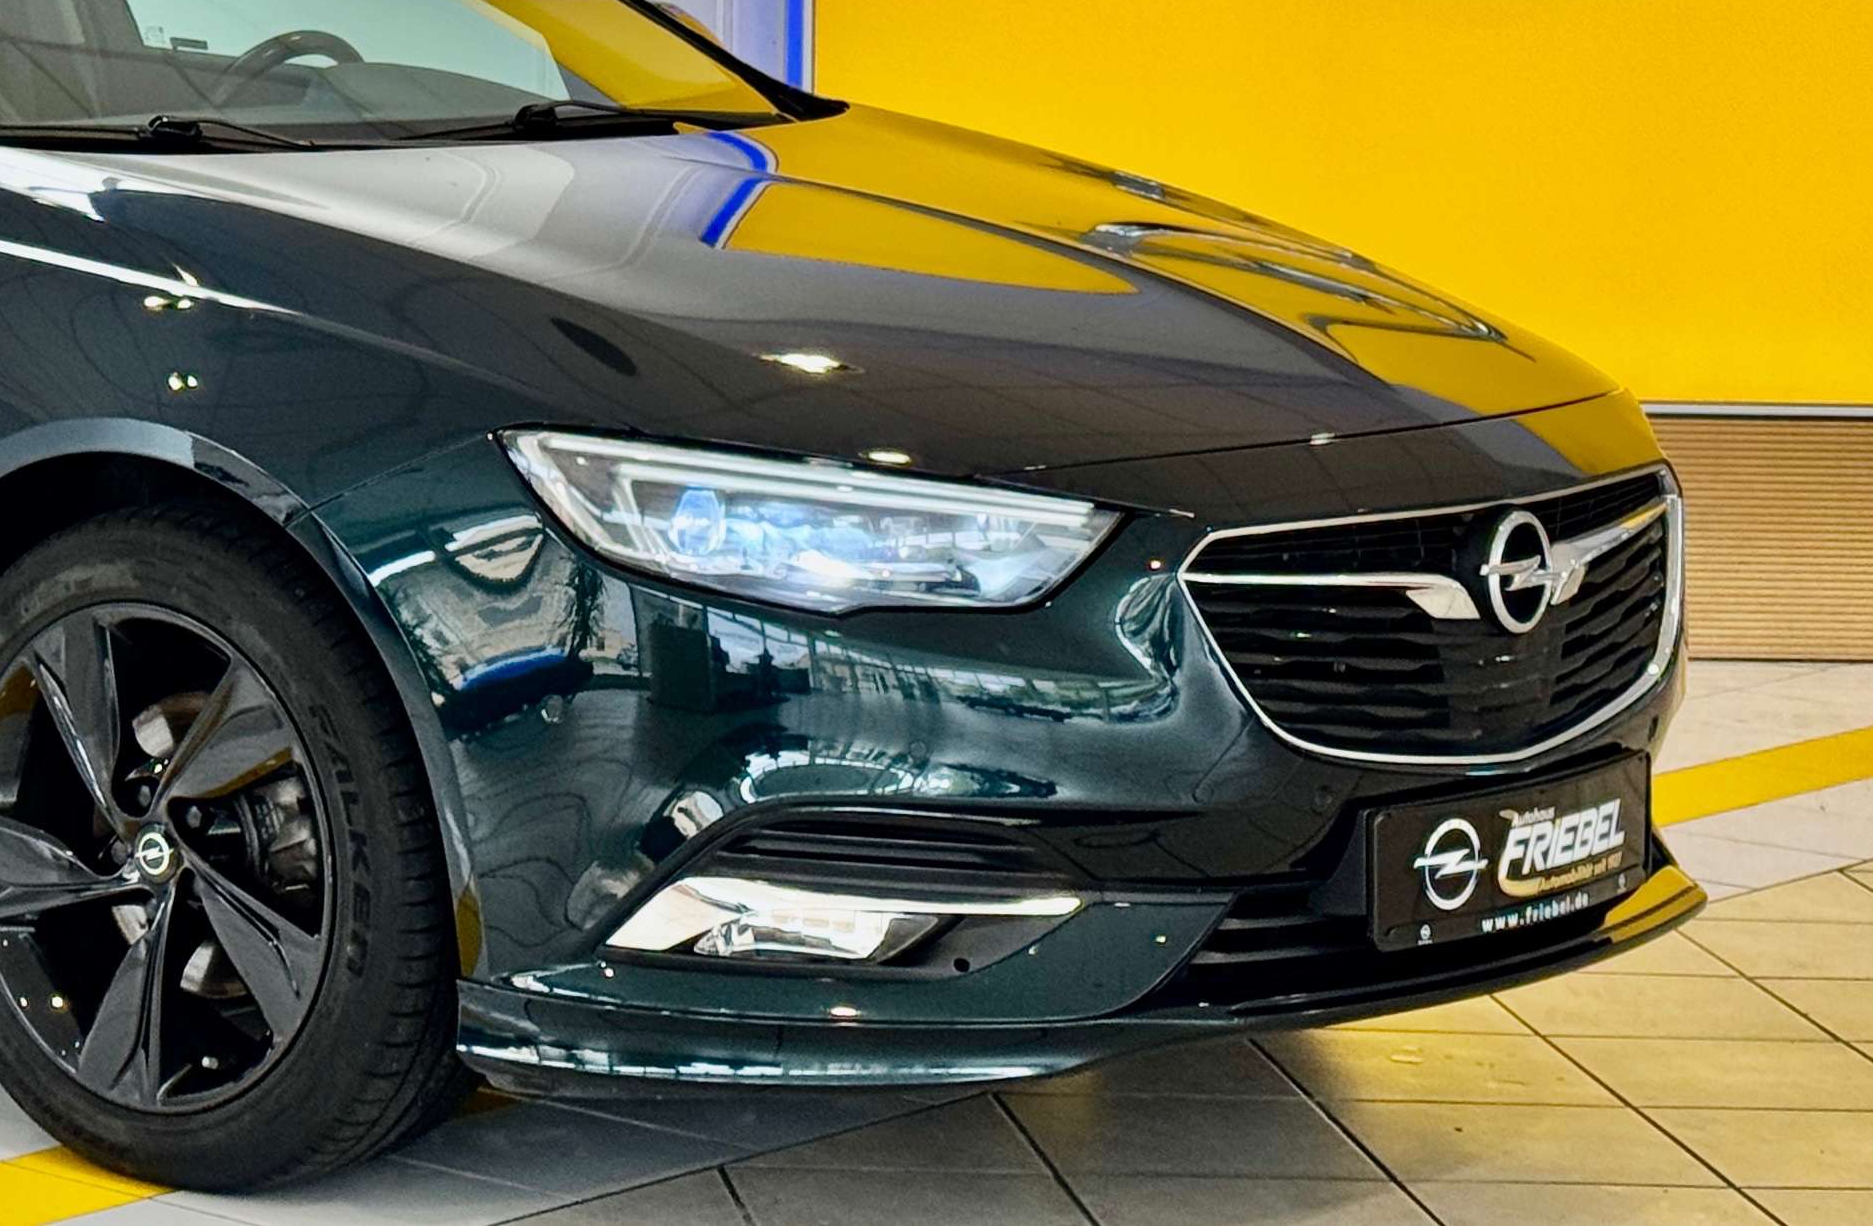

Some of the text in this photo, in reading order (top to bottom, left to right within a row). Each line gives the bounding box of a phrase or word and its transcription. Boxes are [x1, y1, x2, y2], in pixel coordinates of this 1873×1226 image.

[309, 703, 371, 978] FALKEN
[1498, 797, 1626, 876] FRIEBEL
[1481, 890, 1589, 933] www.friebel.de
